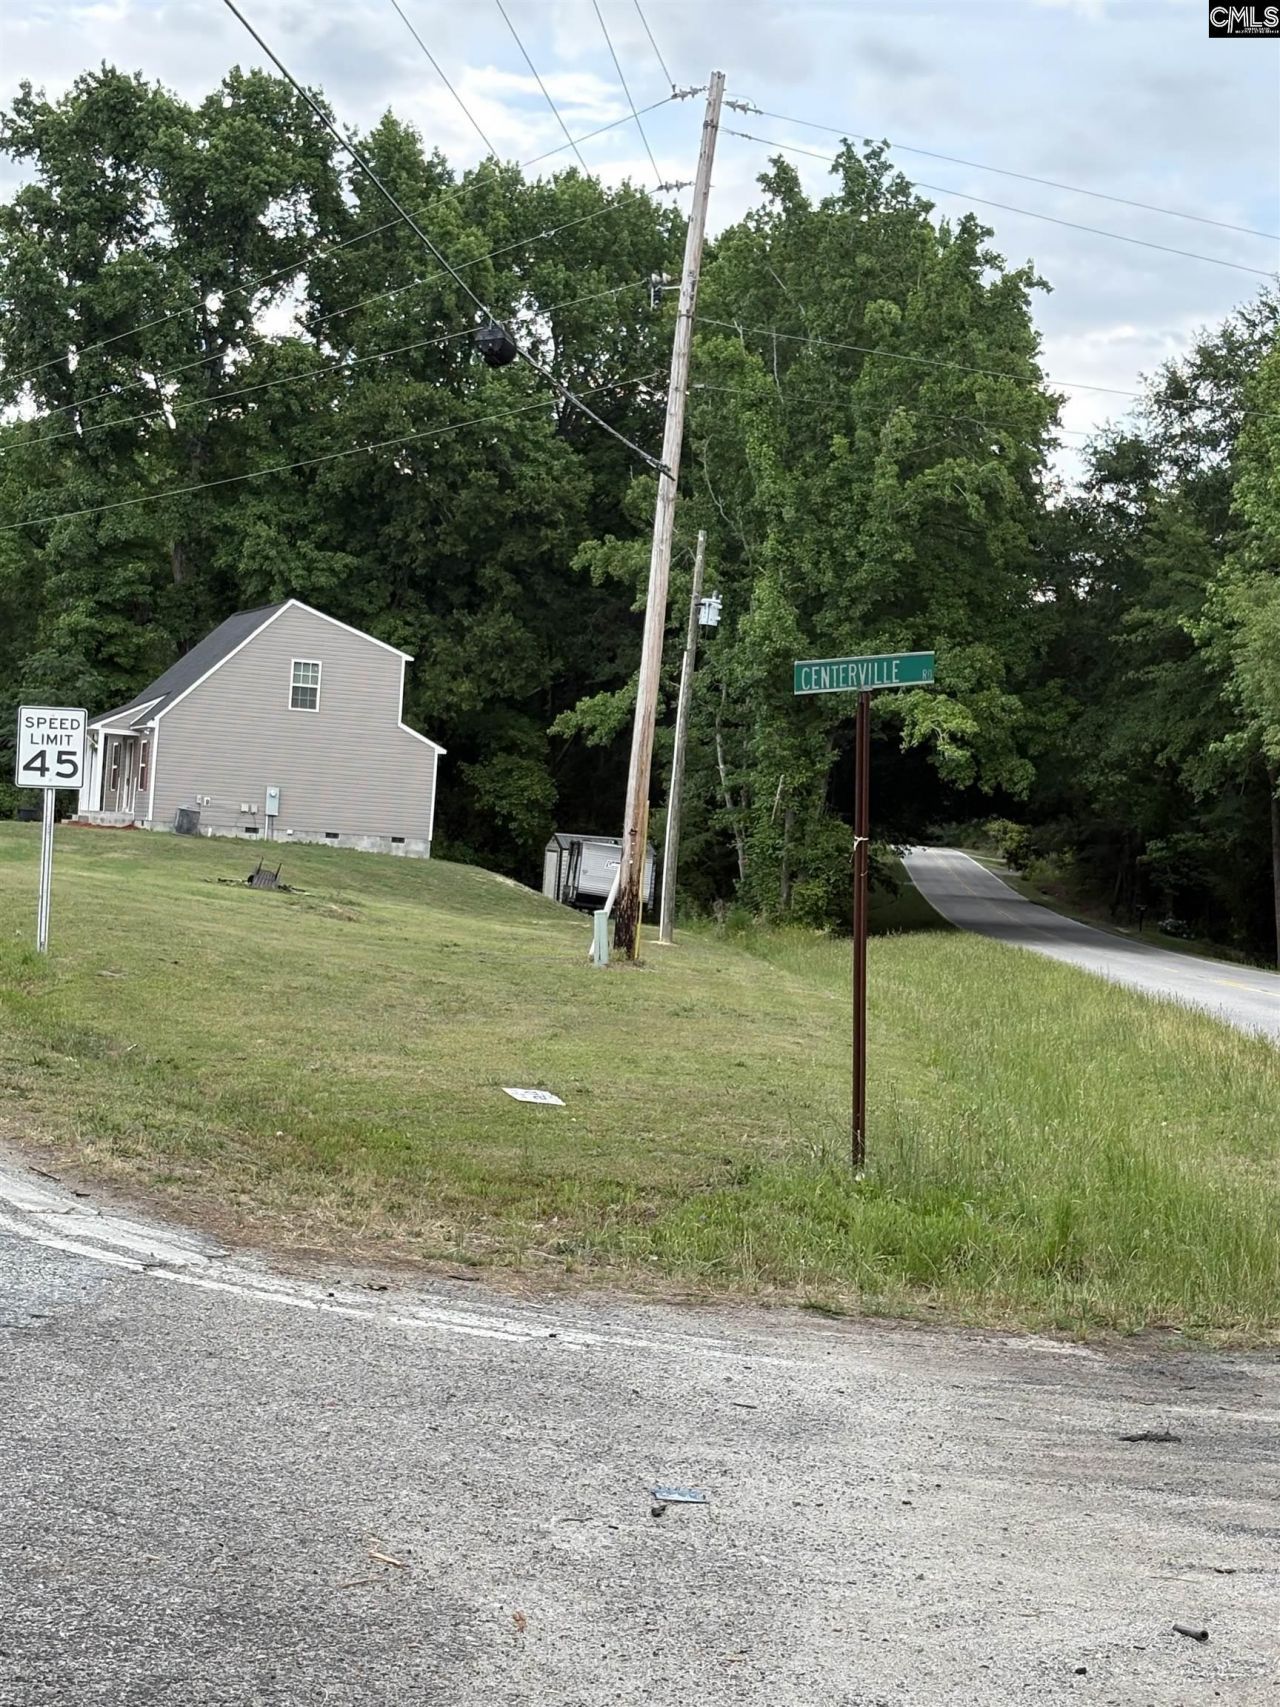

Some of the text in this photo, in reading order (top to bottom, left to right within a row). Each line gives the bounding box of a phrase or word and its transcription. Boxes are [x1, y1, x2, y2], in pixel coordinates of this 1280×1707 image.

[801, 660, 933, 690] CENTERVILLE RD
[25, 716, 81, 730] SPEED
[30, 733, 73, 746] LIMIT
[22, 749, 79, 779] 45
